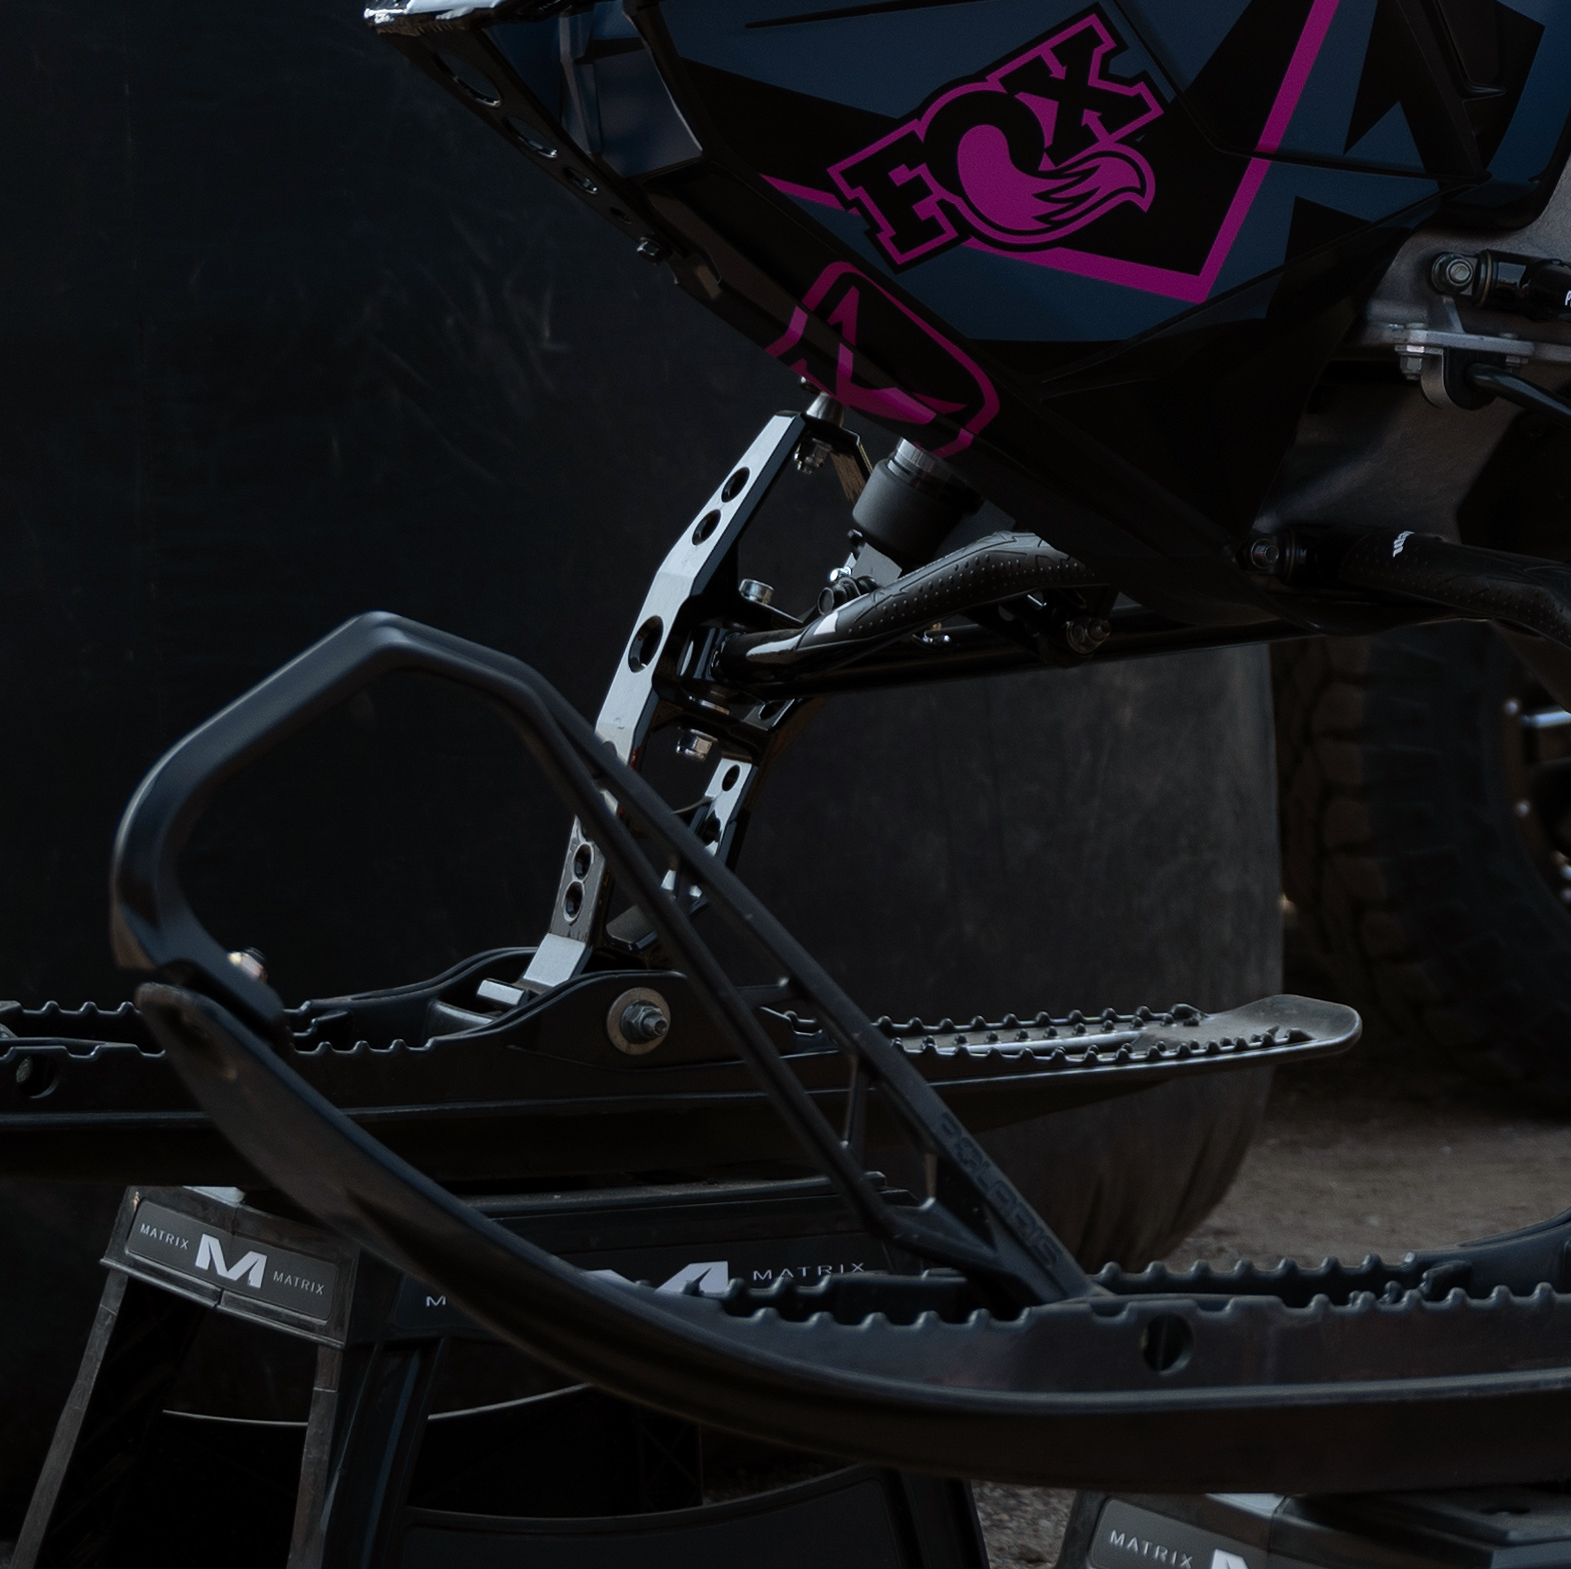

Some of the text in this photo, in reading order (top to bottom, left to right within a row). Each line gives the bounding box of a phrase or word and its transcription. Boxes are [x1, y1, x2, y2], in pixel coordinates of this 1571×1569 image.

[828, 13, 1165, 267] FOX
[139, 1223, 190, 1251] MATRIX
[272, 1270, 325, 1296] MATRIX
[752, 1262, 866, 1282] MATRIX
[1109, 1529, 1194, 1569] MATRIX
